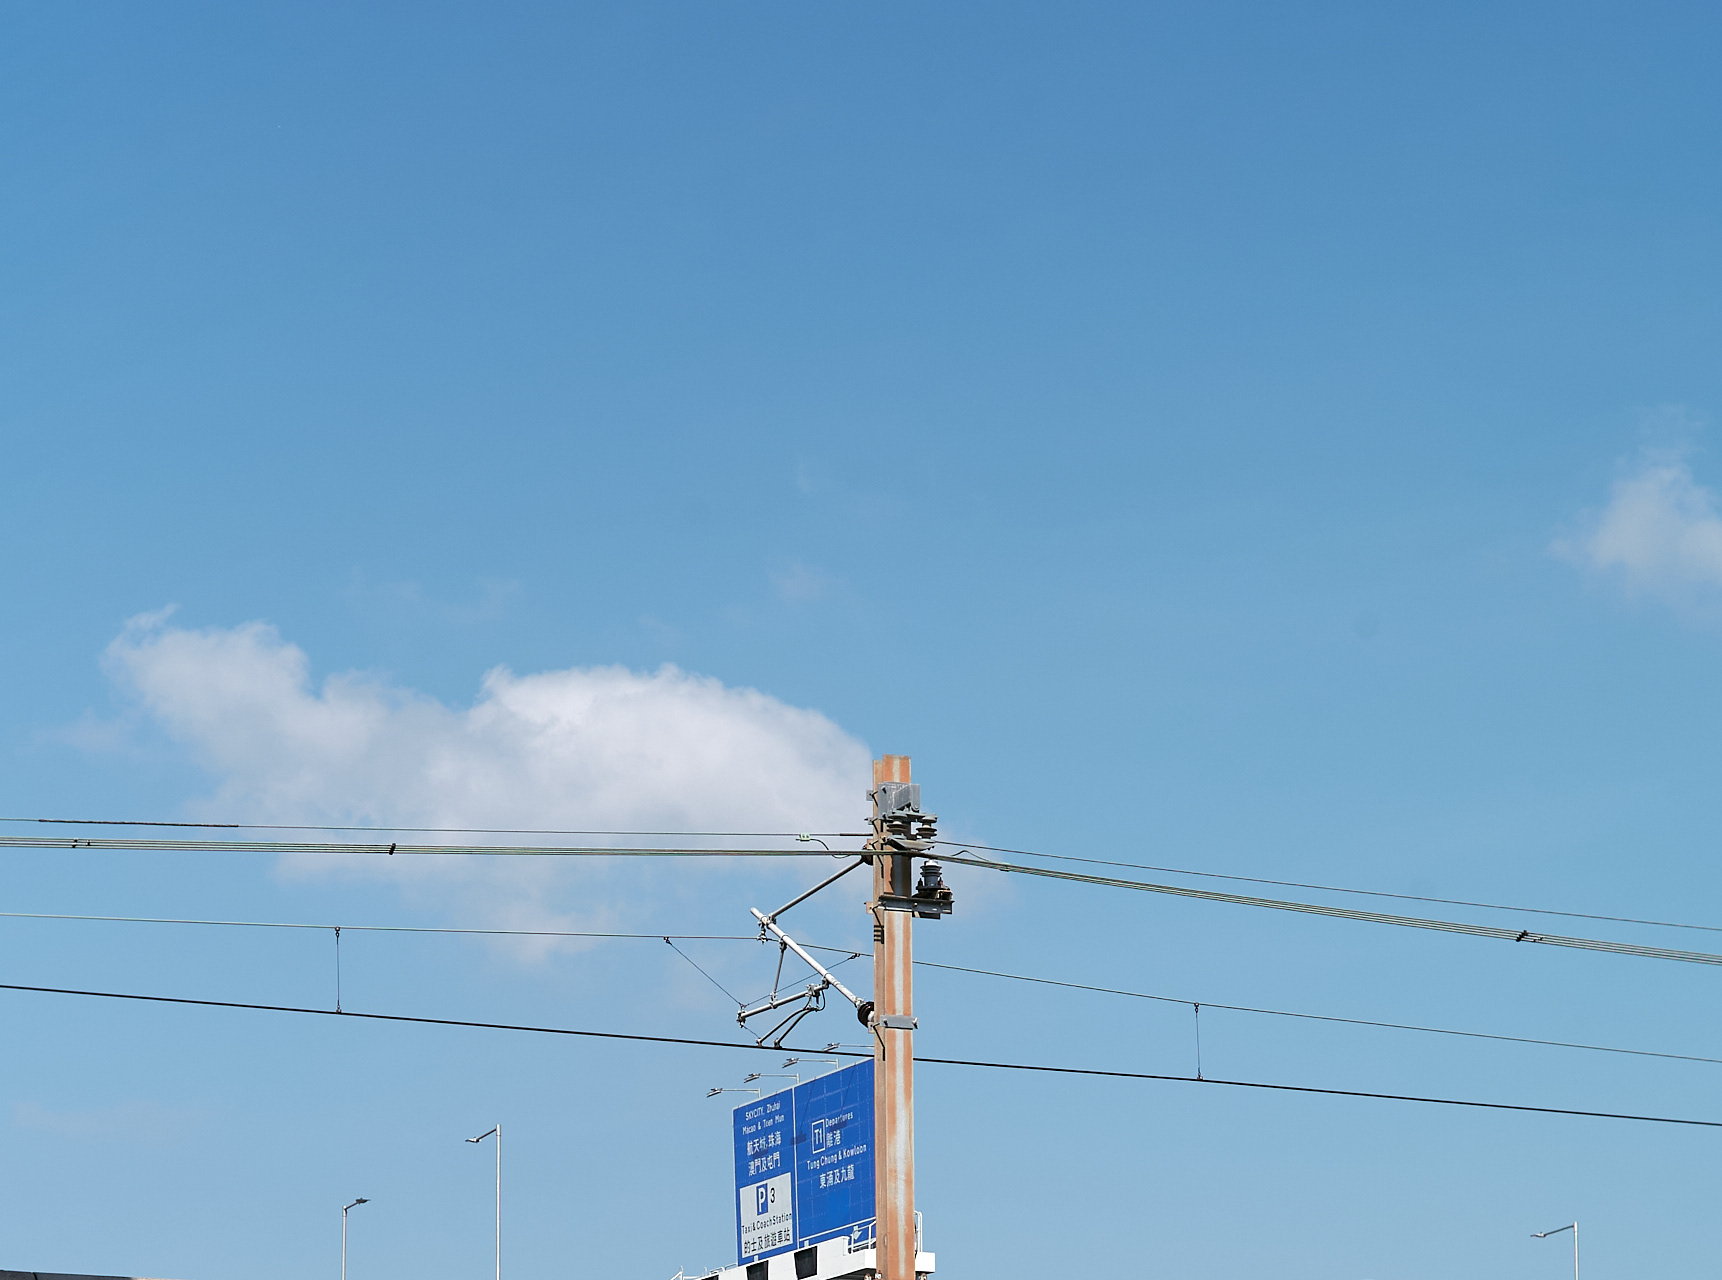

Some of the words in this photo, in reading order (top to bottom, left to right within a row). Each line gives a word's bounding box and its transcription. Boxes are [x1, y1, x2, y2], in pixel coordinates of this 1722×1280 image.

[742, 1125, 756, 1135] Macao
[757, 1121, 762, 1130] &
[775, 1114, 785, 1124] Mun
[825, 1112, 853, 1127] Departures
[814, 1127, 823, 1145] T1
[807, 1160, 820, 1170] Tung
[820, 1153, 837, 1165] Chung
[838, 1150, 842, 1160] &
[843, 1144, 867, 1158] Kowloon
[770, 1187, 776, 1204] 3
[741, 1223, 752, 1234] Taxi
[752, 1222, 756, 1231] &
[756, 1217, 772, 1230] Coach
[773, 1212, 792, 1225] Station
